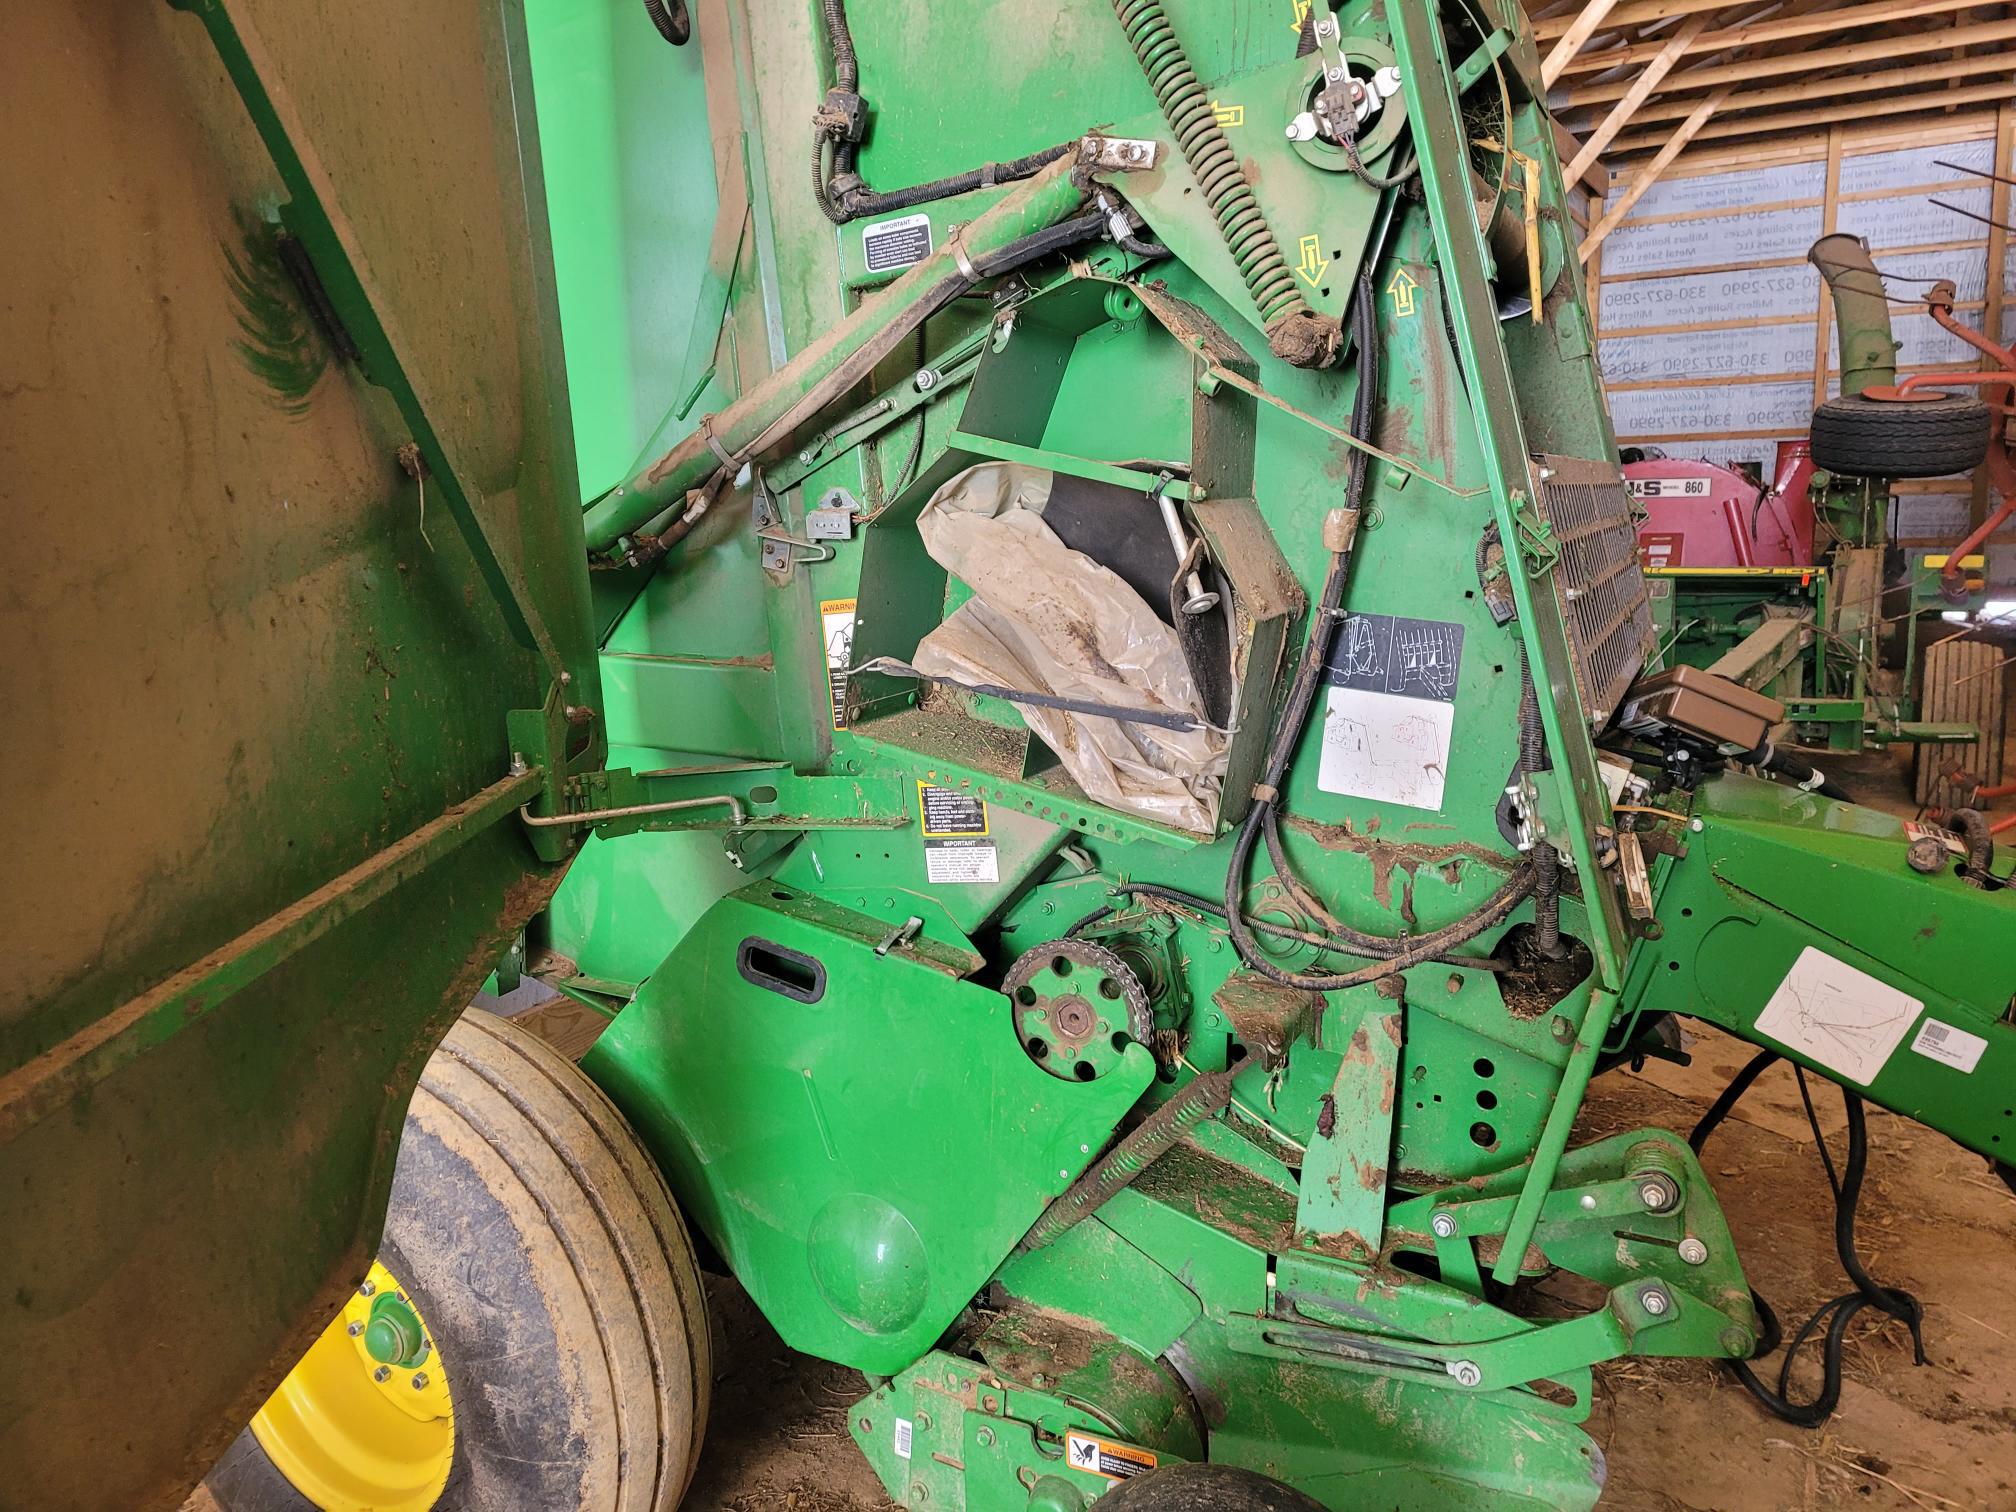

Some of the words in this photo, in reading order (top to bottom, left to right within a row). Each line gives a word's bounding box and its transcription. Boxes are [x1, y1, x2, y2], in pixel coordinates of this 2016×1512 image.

[880, 219, 910, 230] IMPORTANT
[1685, 481, 1703, 494] 860
[828, 603, 855, 612] WARNI
